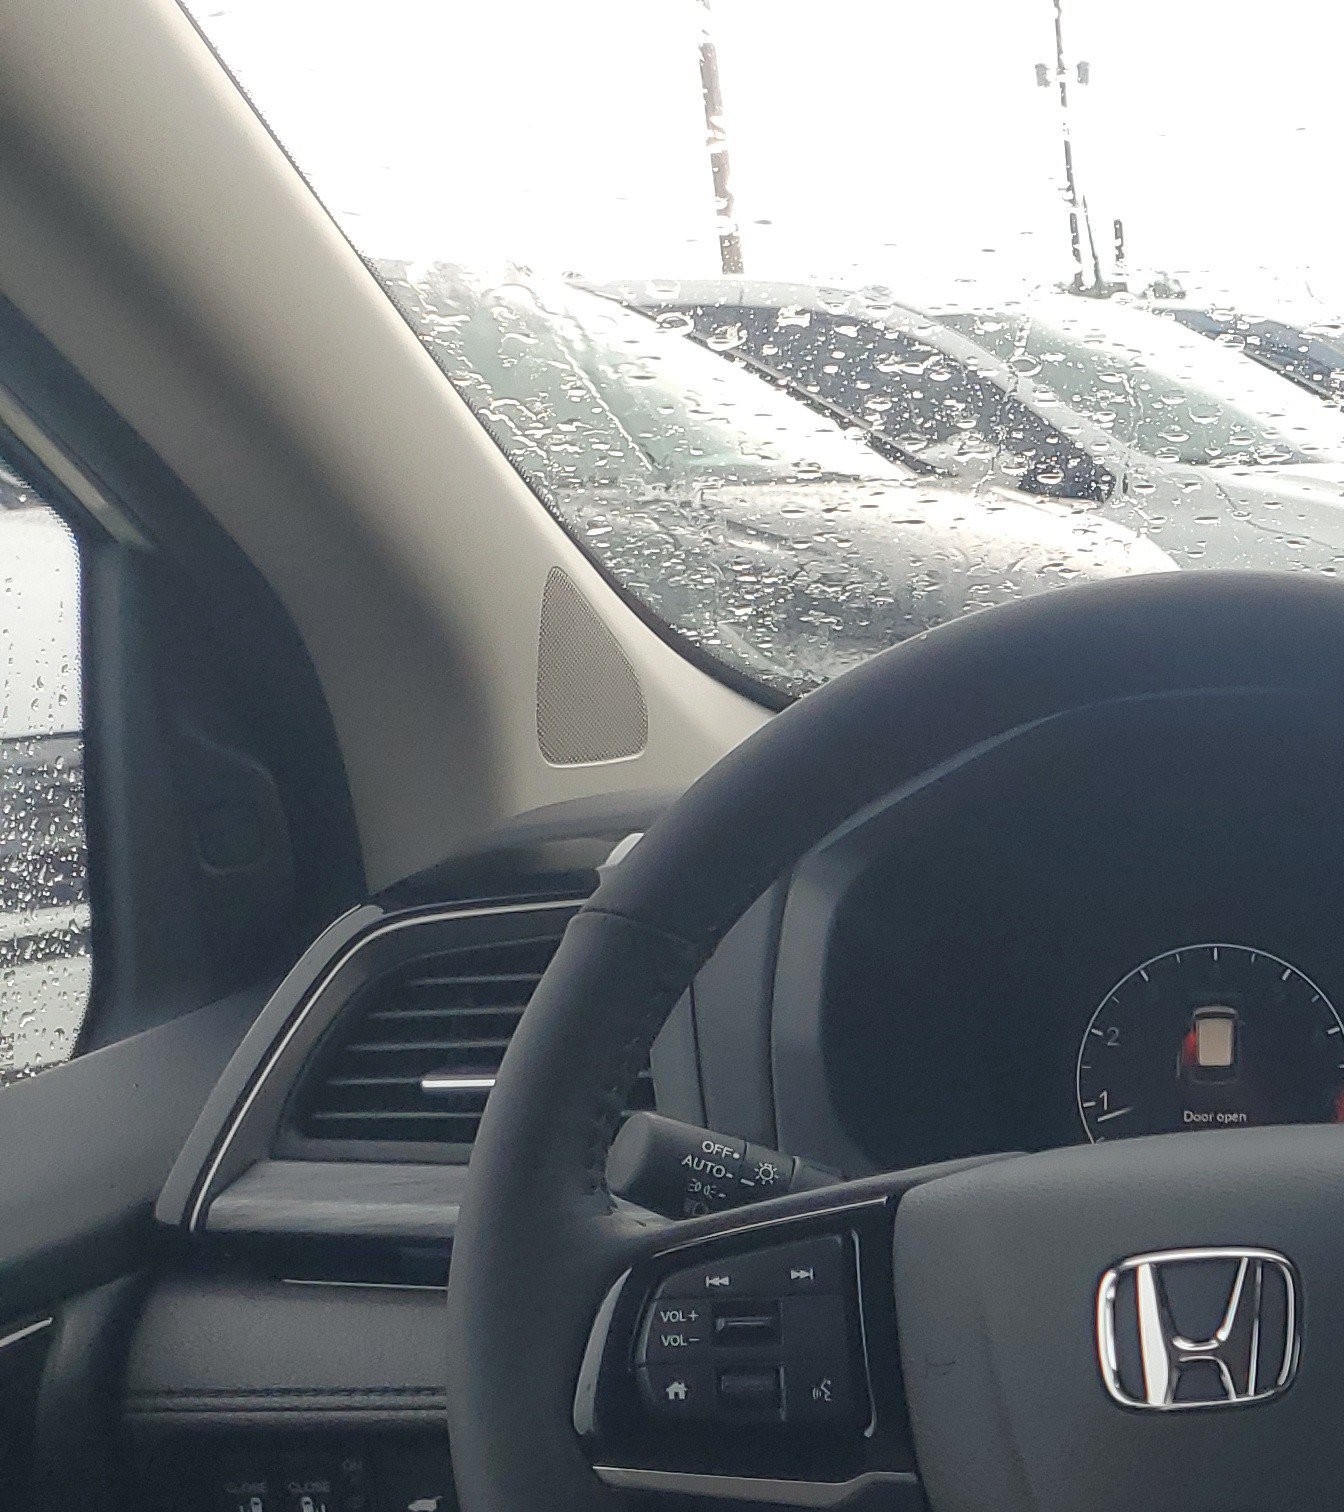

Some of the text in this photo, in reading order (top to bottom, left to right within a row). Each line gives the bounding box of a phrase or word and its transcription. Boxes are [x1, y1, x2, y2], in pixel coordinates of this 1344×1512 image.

[1106, 1026, 1121, 1046] 2
[1098, 1090, 1109, 1111] 1
[1183, 1110, 1247, 1125] Door open
[701, 1140, 734, 1159] OFF
[681, 1154, 726, 1178] AUTO
